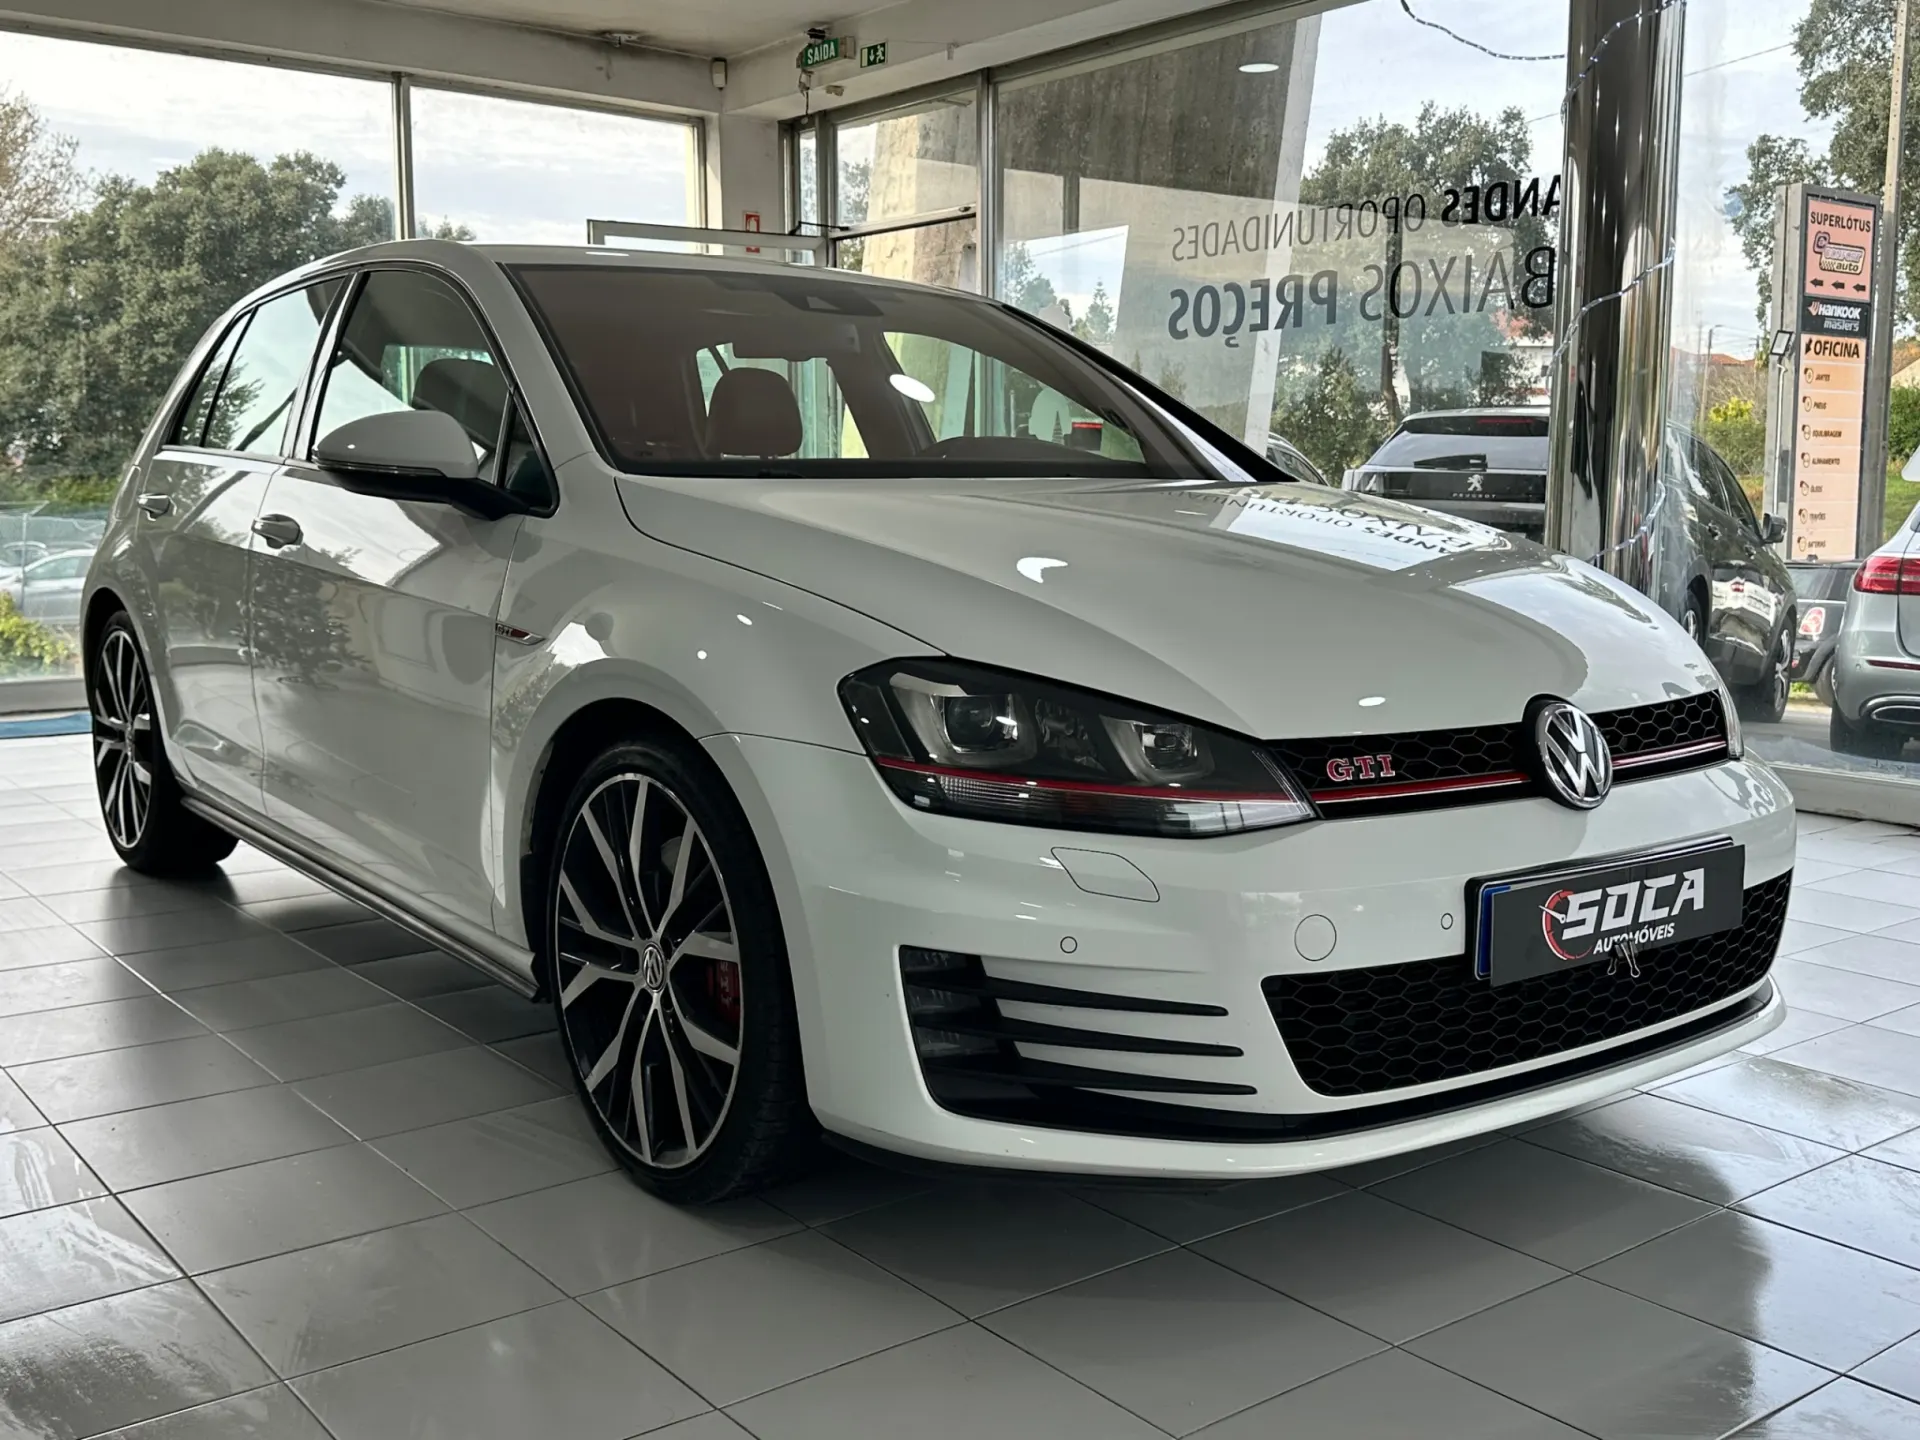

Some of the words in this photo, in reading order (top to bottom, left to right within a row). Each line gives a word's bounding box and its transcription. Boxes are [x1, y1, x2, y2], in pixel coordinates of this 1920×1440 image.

[1810, 211, 1871, 233] SUPERLÓTUS
[1836, 262, 1859, 272] auto
[1813, 340, 1860, 359] OFICINA
[1326, 754, 1396, 781] GTI
[1562, 868, 1705, 940] SOCA
